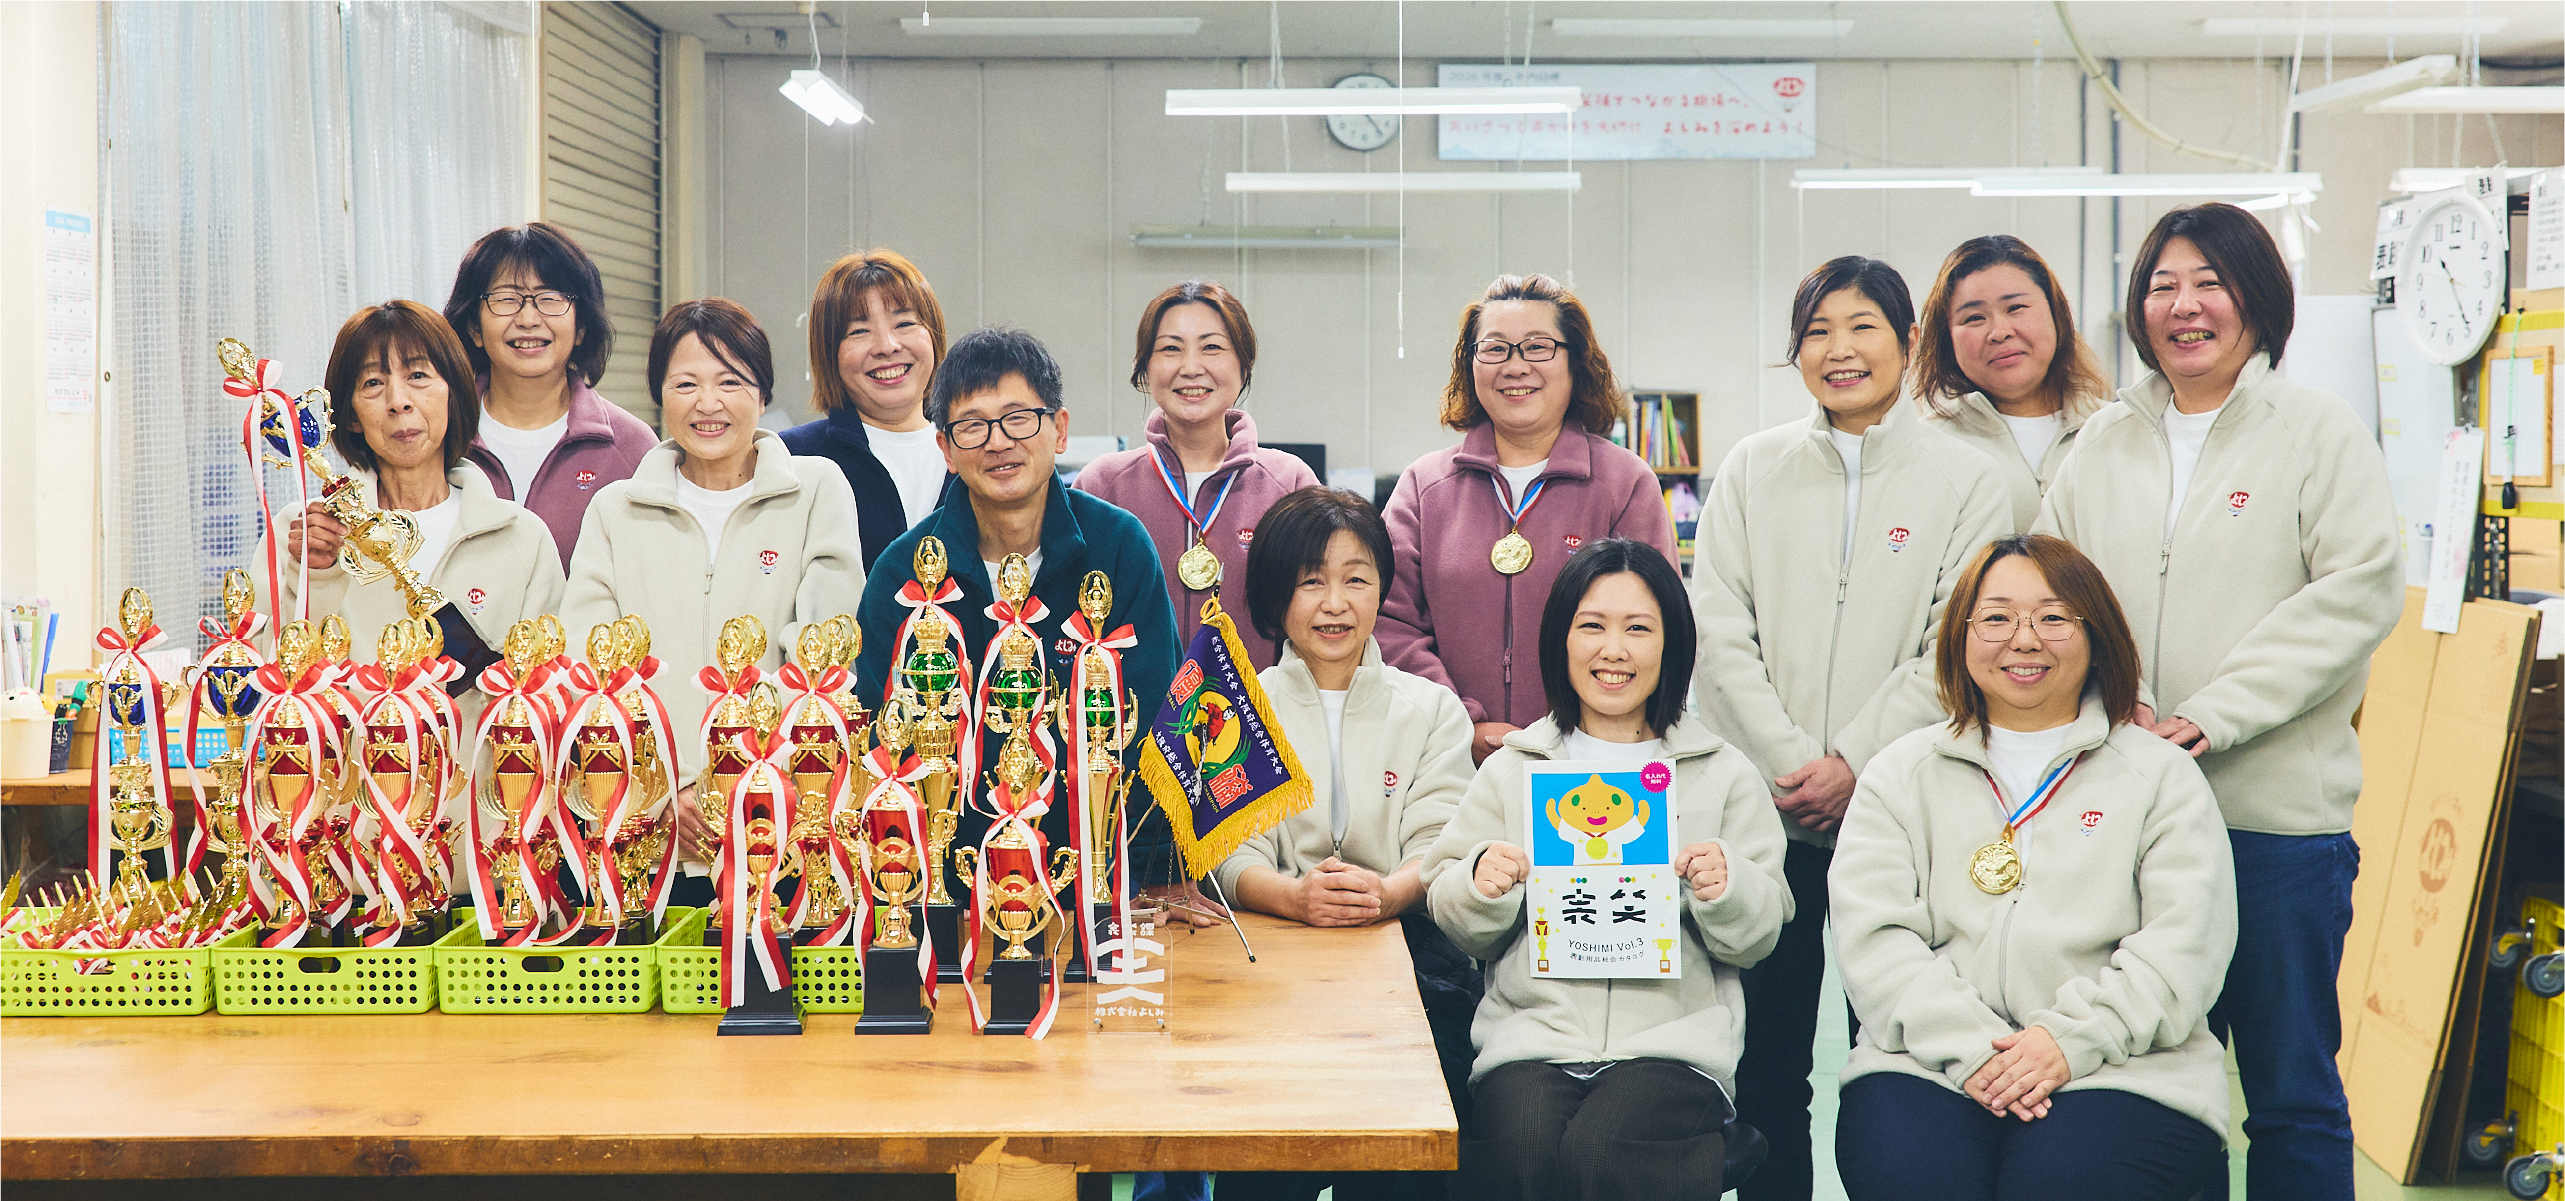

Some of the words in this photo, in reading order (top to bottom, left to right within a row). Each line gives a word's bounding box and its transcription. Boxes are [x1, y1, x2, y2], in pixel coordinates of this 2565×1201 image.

[2435, 223, 2443, 241] 11
[2451, 214, 2462, 233] 12
[2422, 244, 2432, 262] 10
[2481, 241, 2489, 260] 2
[2416, 272, 2424, 291] 9
[2484, 270, 2491, 289] 3
[2420, 300, 2426, 318] 8
[2476, 300, 2482, 315] 4
[2430, 321, 2437, 337] 7
[2447, 328, 2453, 345] 6
[1054, 639, 1077, 652] よしみ
[1236, 694, 1283, 775] 大阪府総合体育大会
[1568, 939, 1613, 952] YOSHIMI
[1616, 937, 1644, 951] Vol.3
[1095, 1006, 1165, 1017] 株式会社よしみ
